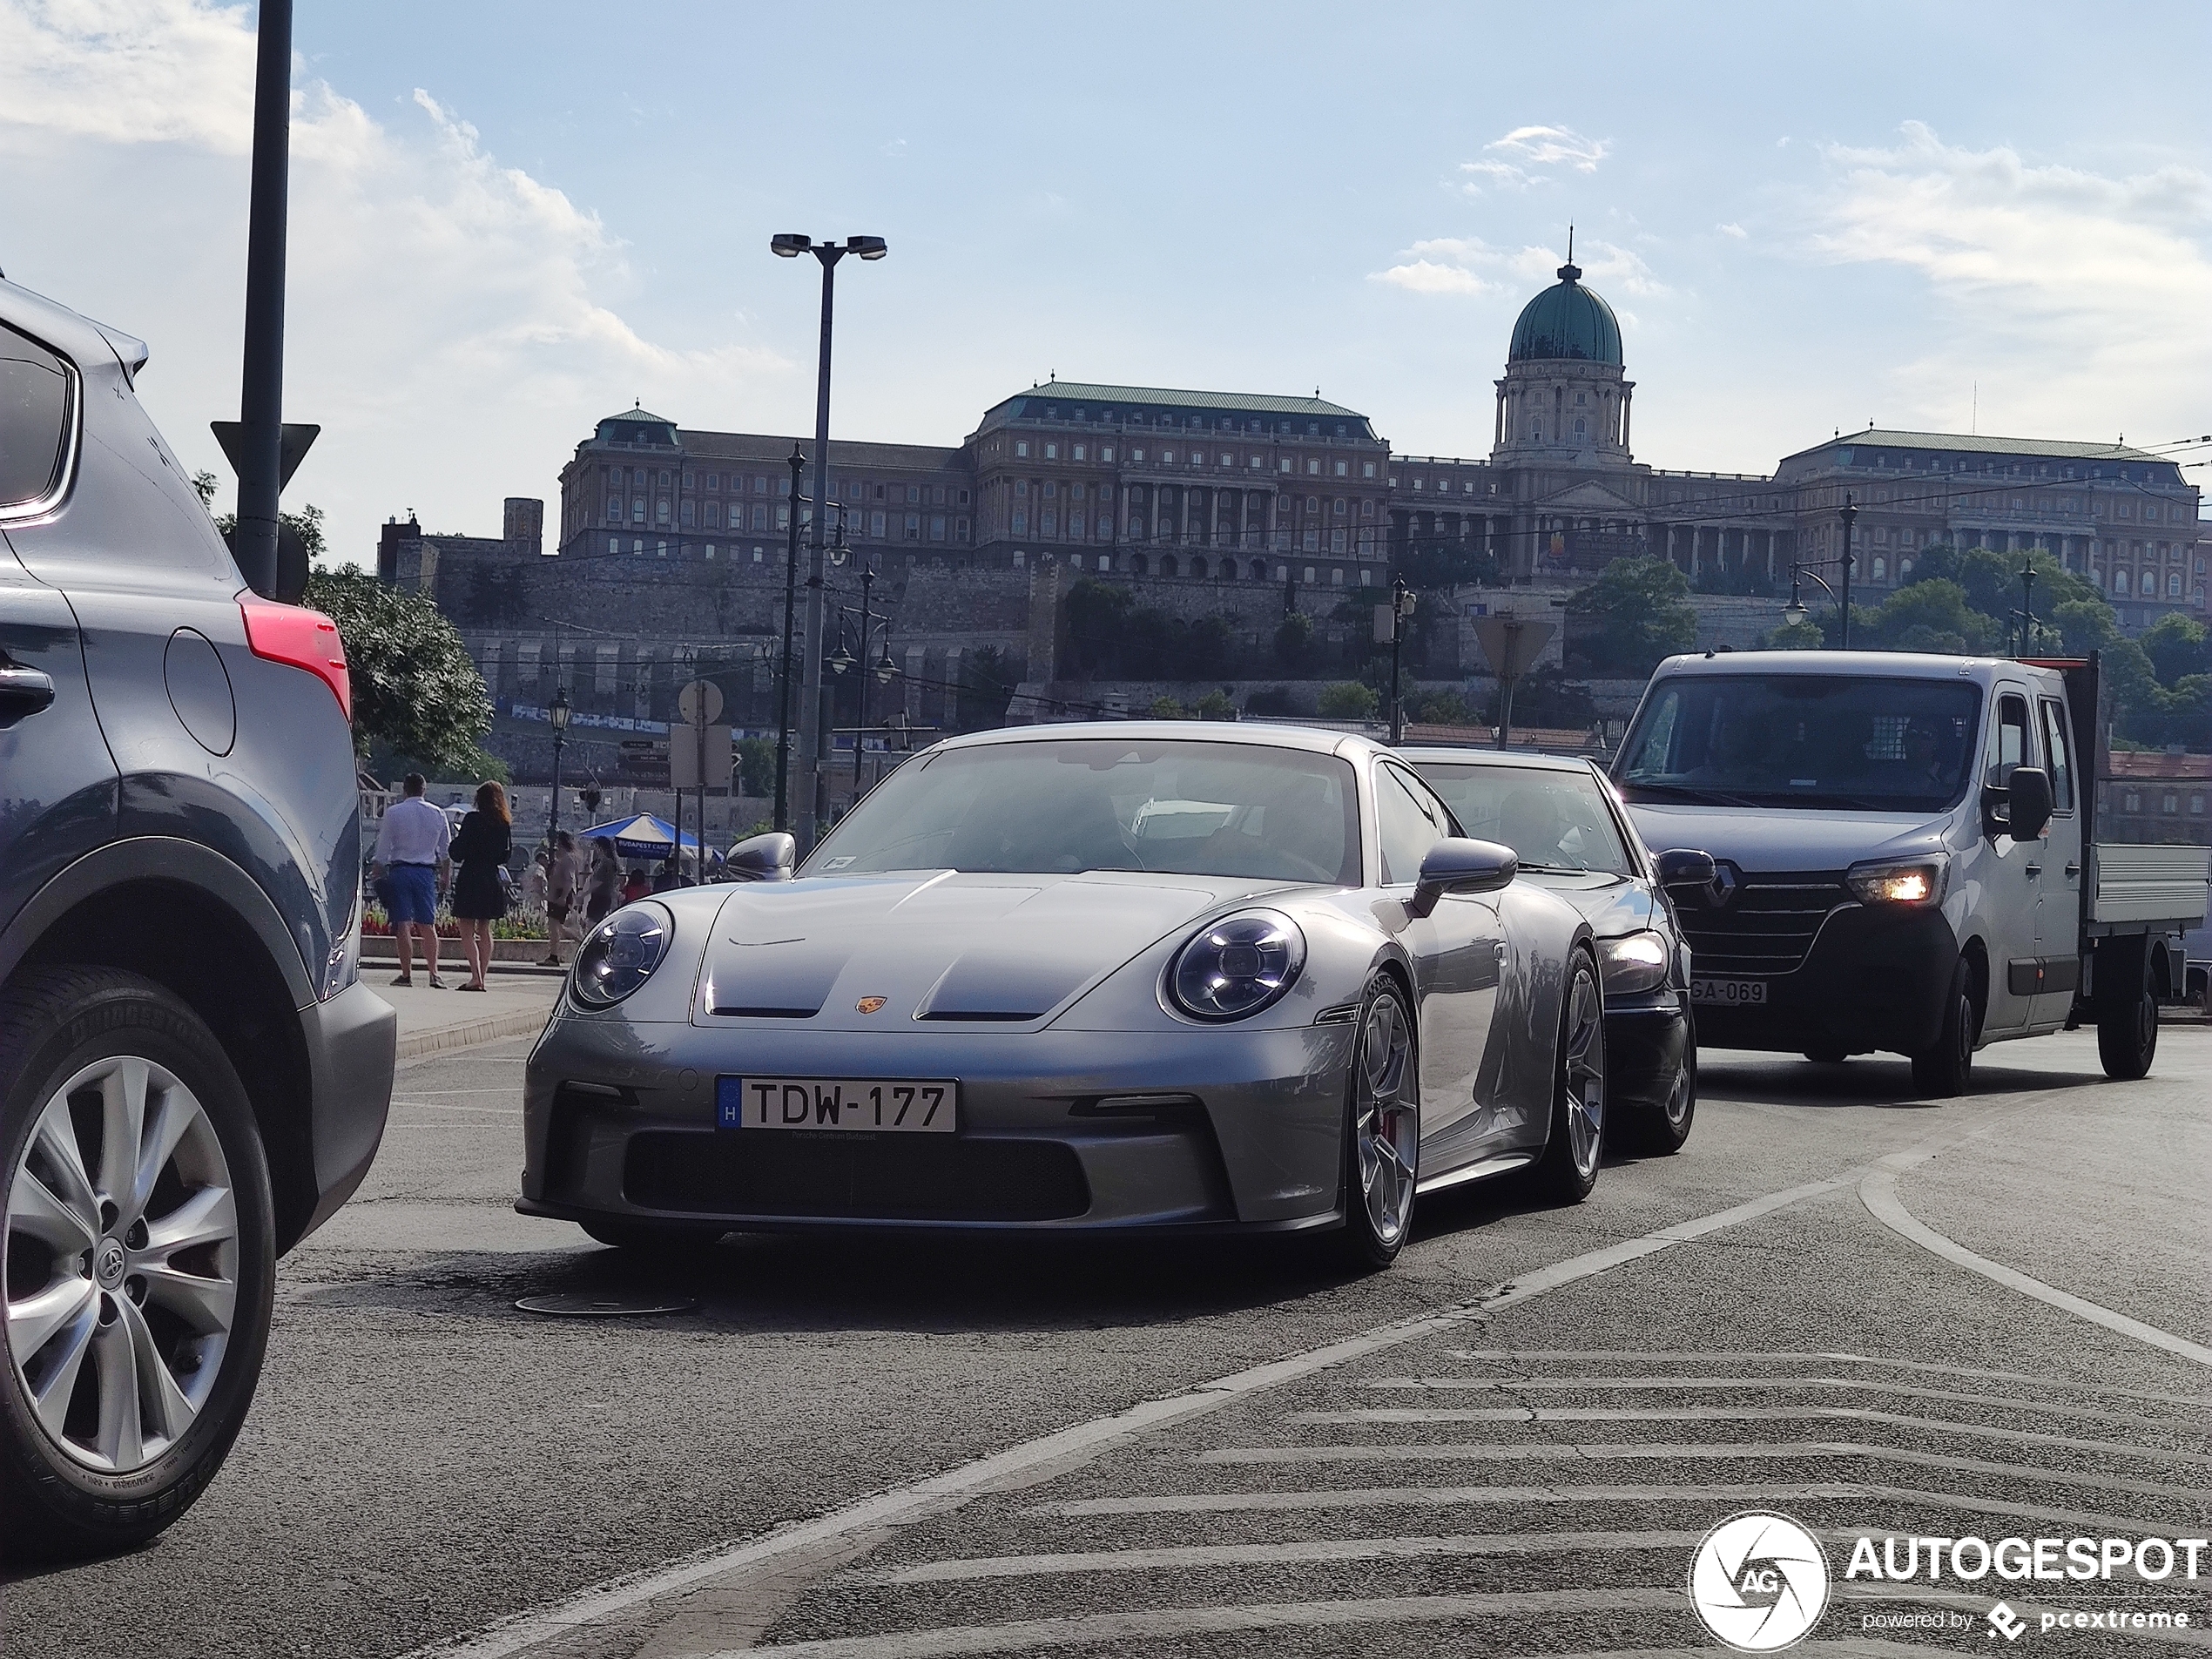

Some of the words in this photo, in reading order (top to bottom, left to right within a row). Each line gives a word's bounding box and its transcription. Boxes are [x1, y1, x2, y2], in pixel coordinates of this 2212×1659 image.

[618, 840, 651, 849] BUDAPEST
[751, 1084, 944, 1126] TDW-177
[725, 1107, 735, 1121] H
